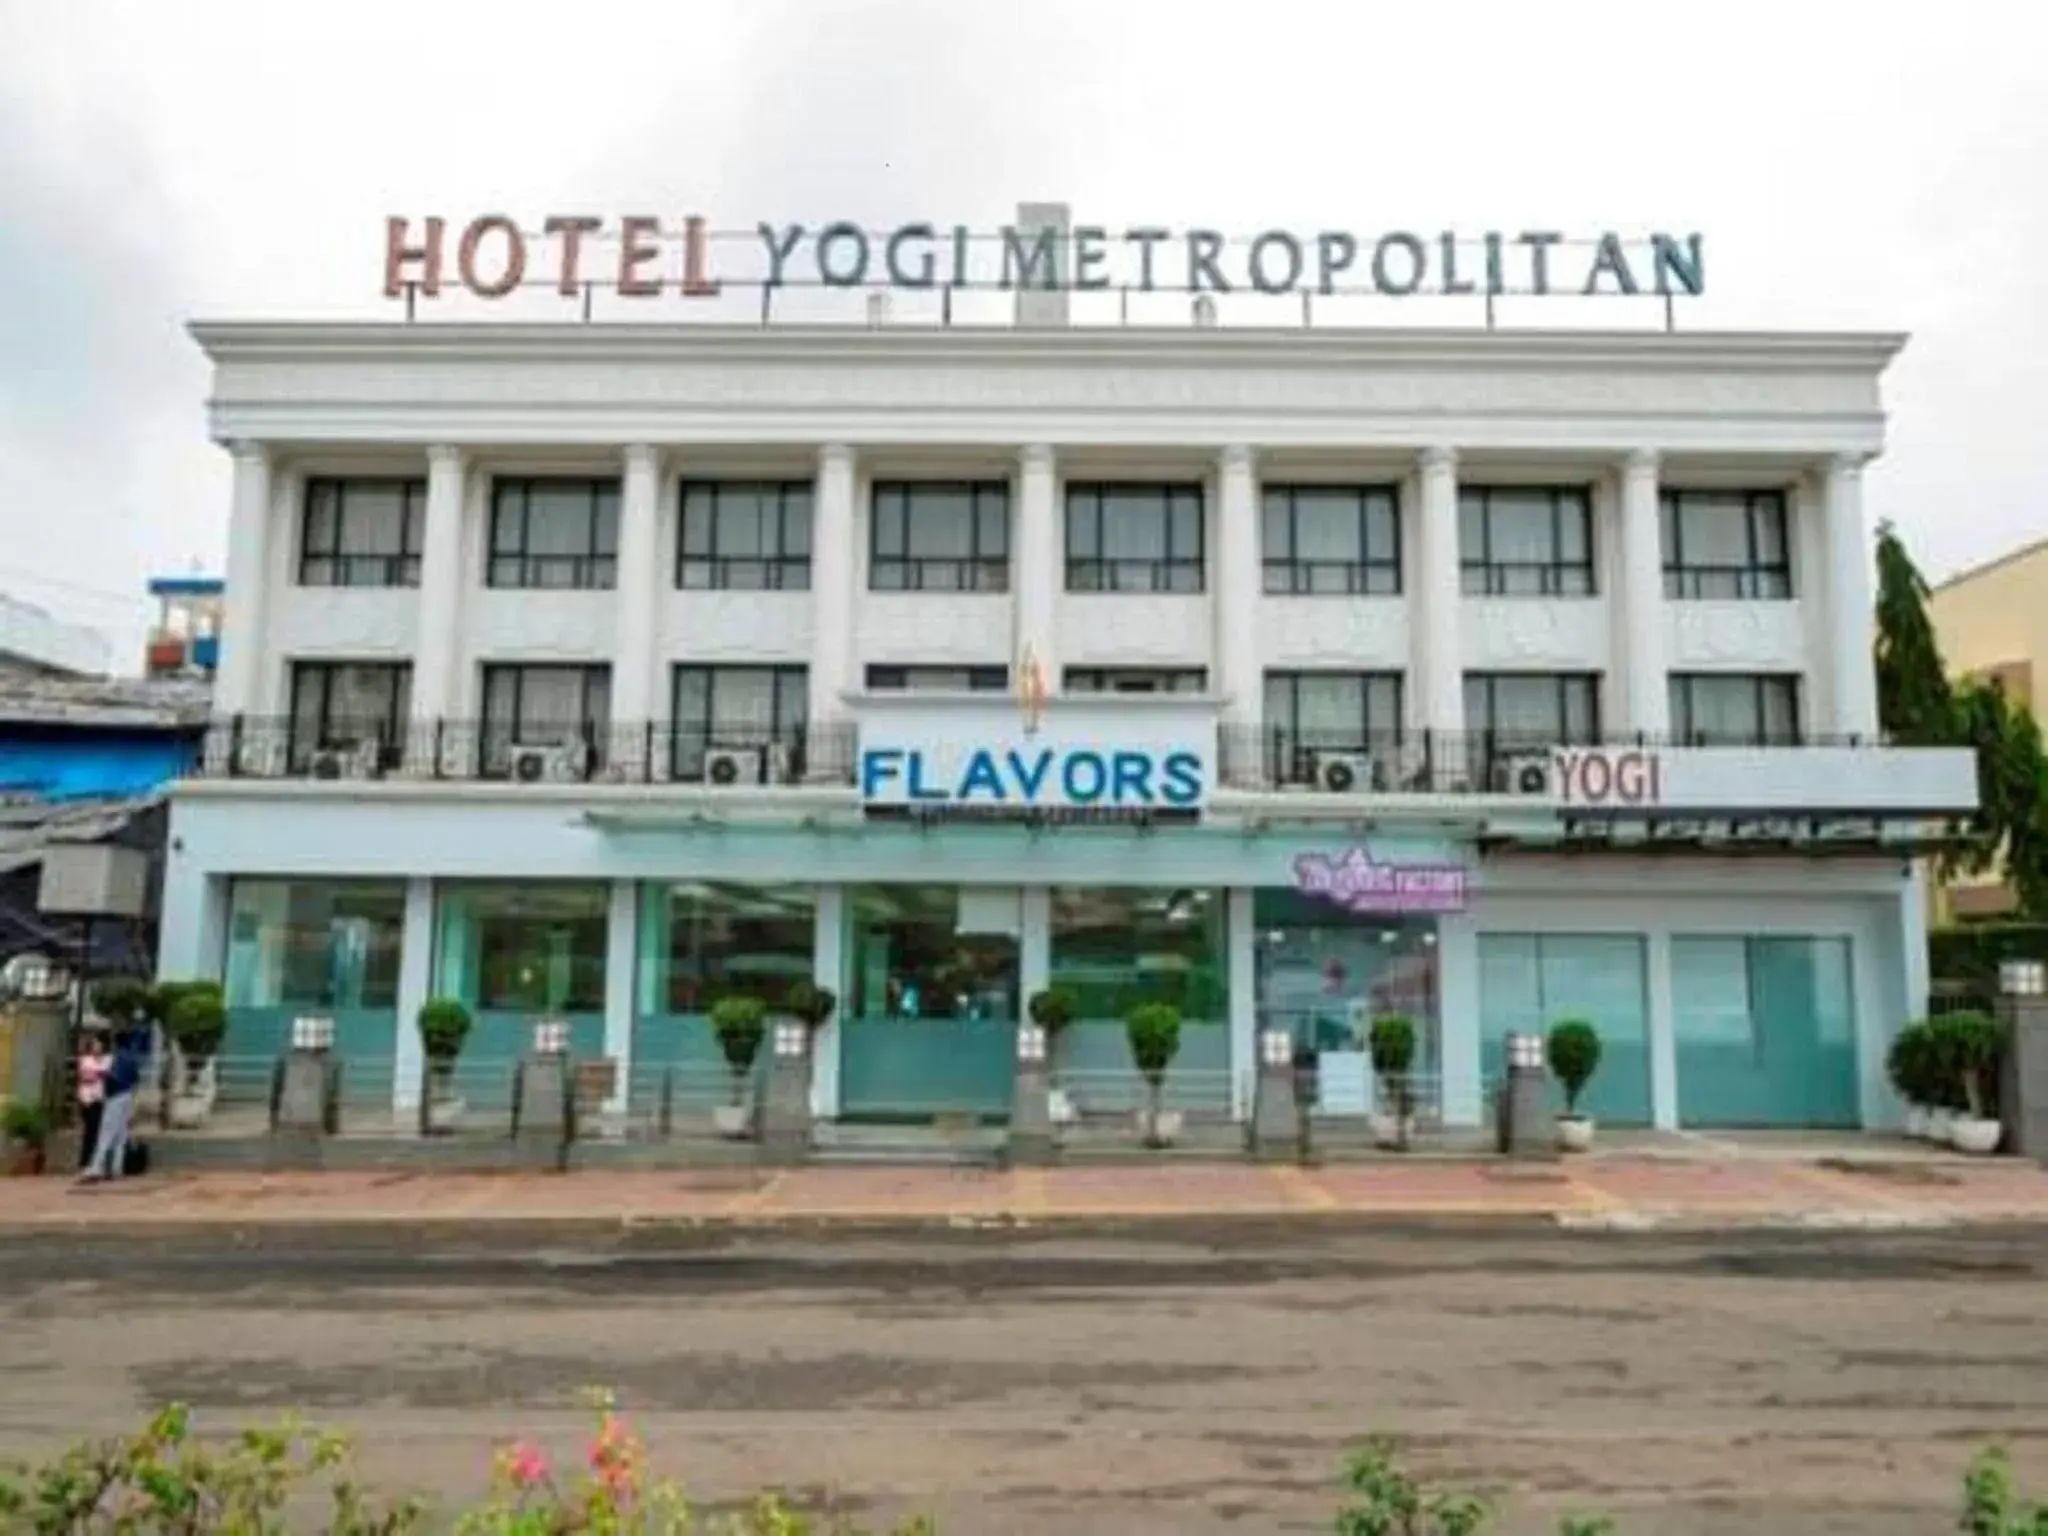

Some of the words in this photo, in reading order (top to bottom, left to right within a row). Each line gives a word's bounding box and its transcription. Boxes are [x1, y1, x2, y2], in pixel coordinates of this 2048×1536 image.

[382, 215, 721, 299] HOTEL
[758, 221, 967, 289] YOGI
[999, 222, 1706, 296] METROPOLITAN
[863, 747, 1203, 803] FLAVORS
[1554, 745, 1660, 804] YOGI
